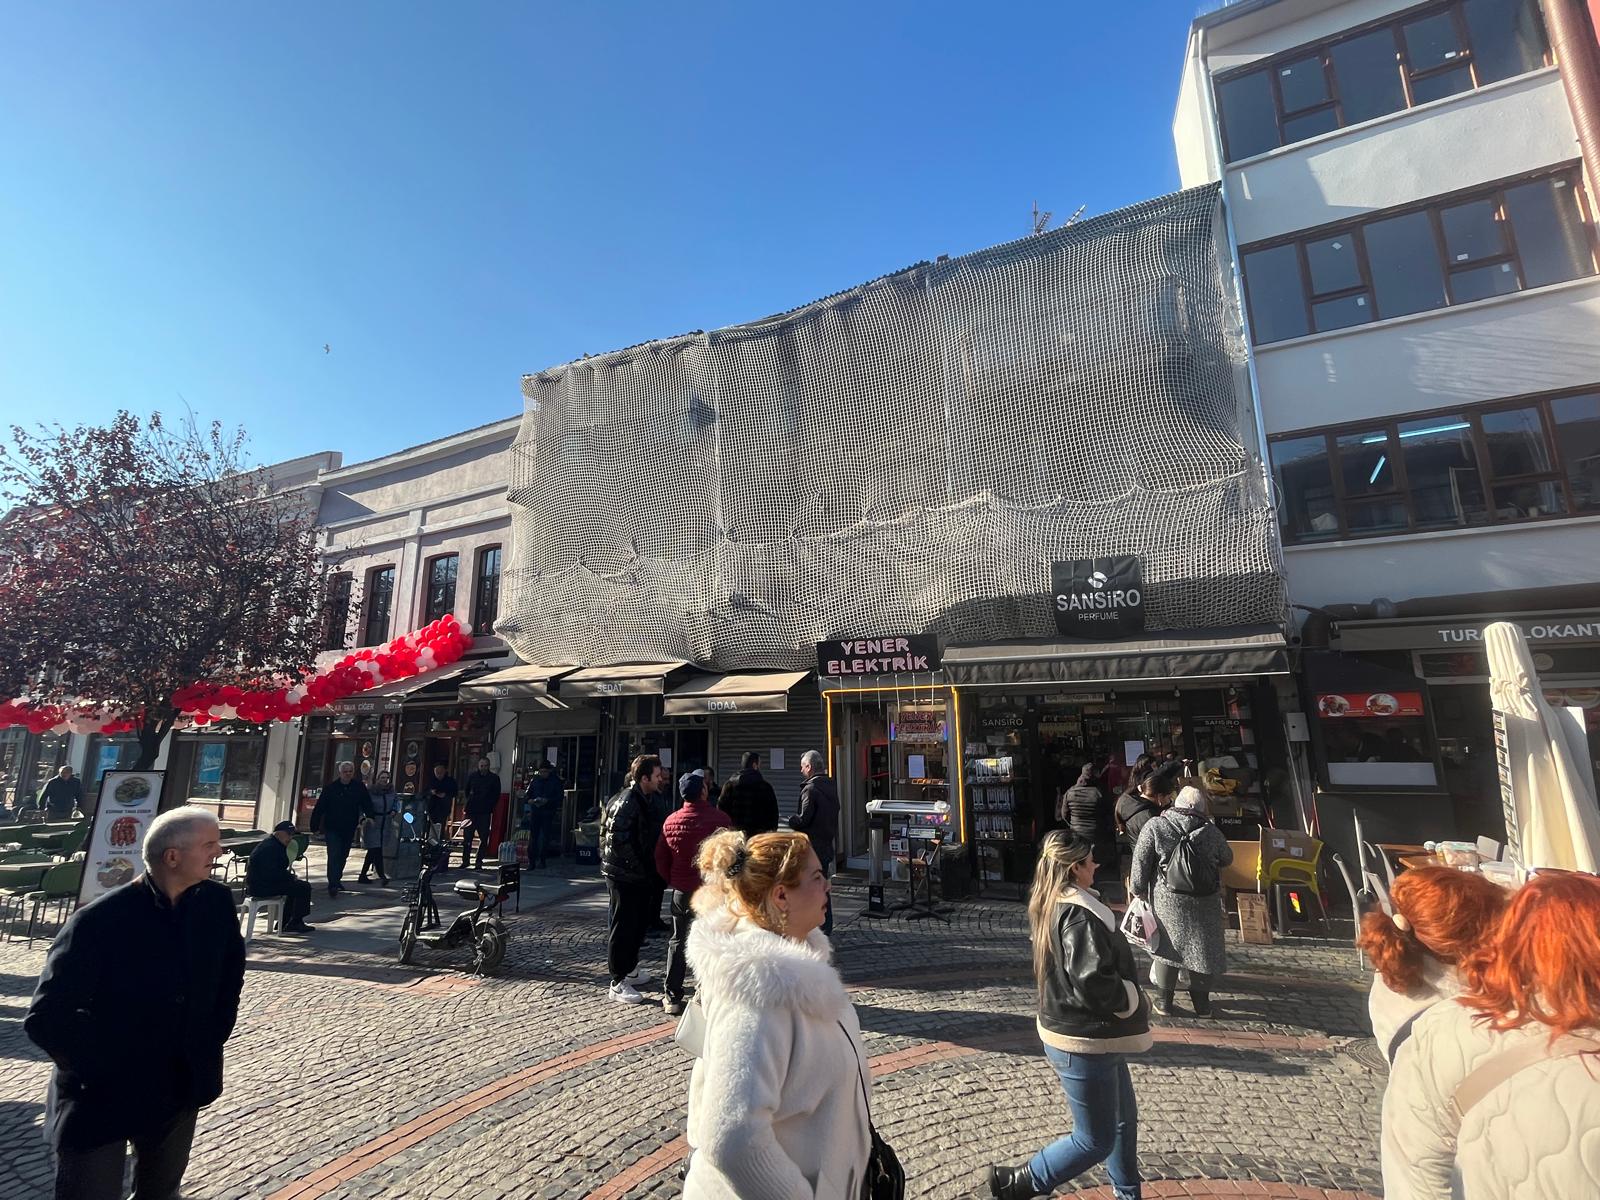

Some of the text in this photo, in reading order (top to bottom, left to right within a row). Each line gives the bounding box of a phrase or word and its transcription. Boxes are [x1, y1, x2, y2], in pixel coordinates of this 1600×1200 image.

[1078, 611, 1119, 622] PERFUME
[840, 638, 910, 656] YENER
[827, 653, 929, 674] ELEKTRİK
[597, 683, 624, 693] SEDAT
